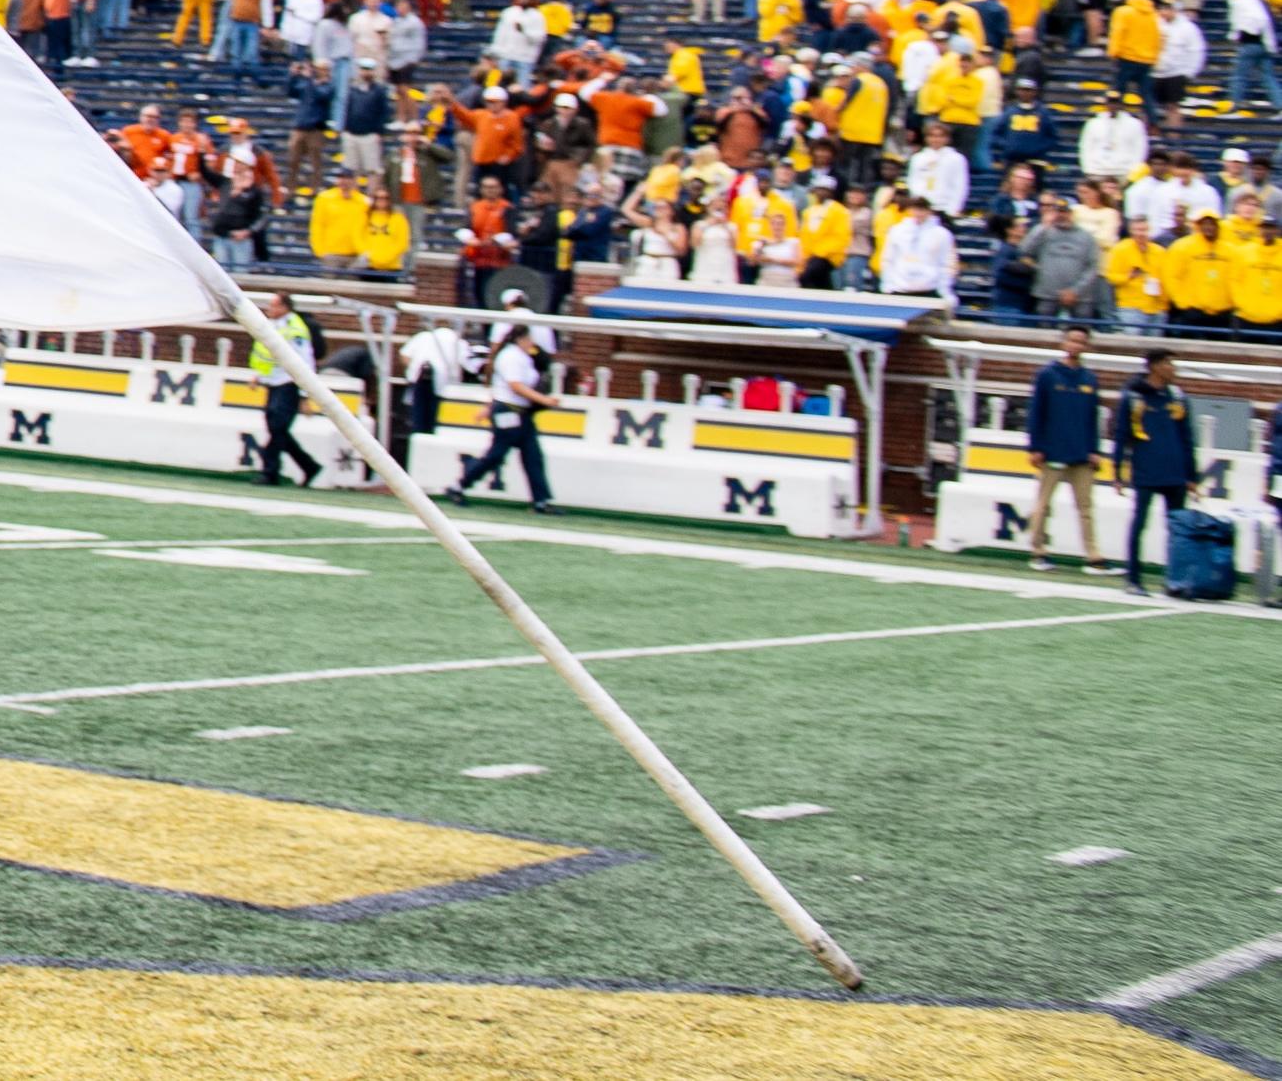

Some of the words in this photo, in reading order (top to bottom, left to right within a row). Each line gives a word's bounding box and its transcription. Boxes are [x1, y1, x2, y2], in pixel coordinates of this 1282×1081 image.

[150, 369, 200, 405] M
[9, 409, 52, 444] M
[611, 408, 667, 448] M
[724, 477, 777, 516] M
